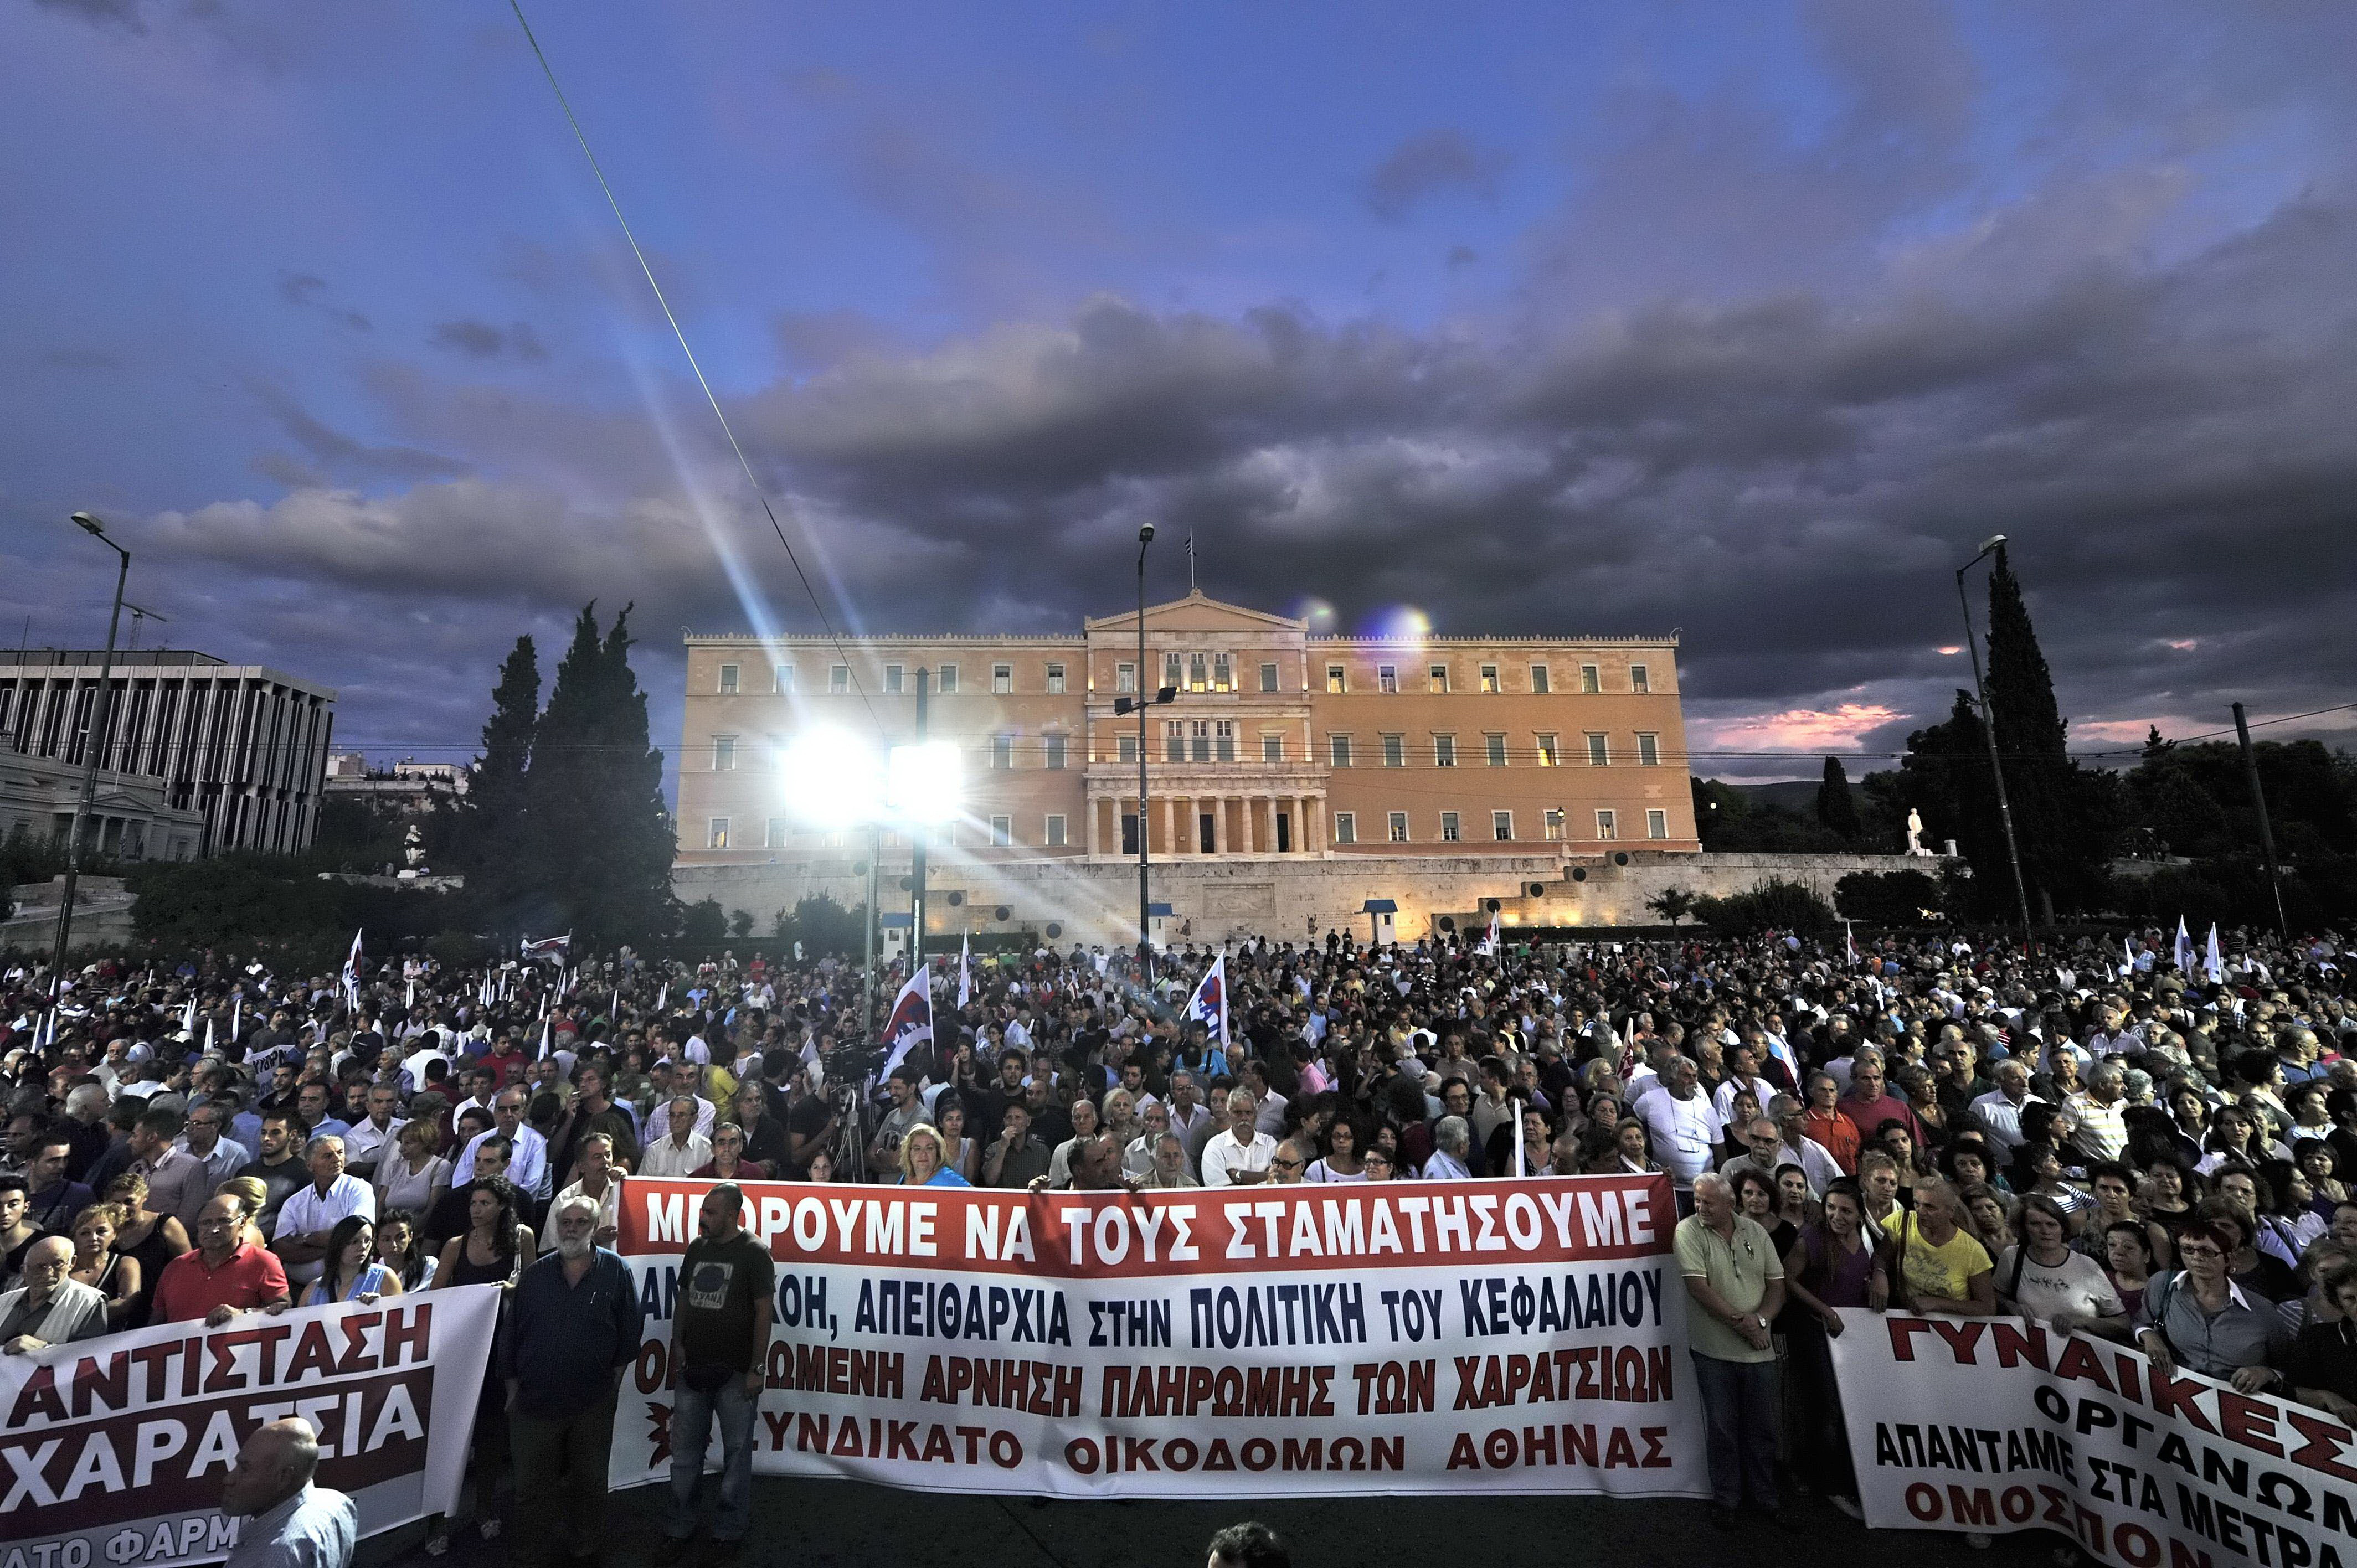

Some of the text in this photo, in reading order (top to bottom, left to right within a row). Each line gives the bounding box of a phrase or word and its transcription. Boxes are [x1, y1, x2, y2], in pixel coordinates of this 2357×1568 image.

[965, 1204, 1036, 1262] ΝΑ
[1061, 1205, 1199, 1265] ΤΟΥΣ
[1225, 1189, 1655, 1258] ΣΤΑΜΑΤΗΣΟΥΜΕ
[854, 1279, 1071, 1347] ΑΠΕΙΘΑΡΧΙΑ
[1089, 1298, 1171, 1347] ΣΤΗΝ
[1190, 1282, 1367, 1349] ΠΟΛΙΤΙΚΗ
[1381, 1289, 1442, 1344] ΤΟΥ
[1460, 1268, 1662, 1337] ΚΕΦΑΛΑΙΟΥ
[7, 1303, 433, 1428] ΑΝΤΙΣΤΑΣΗ
[921, 1354, 1082, 1417] ΑΡΝΗΣΗ
[1101, 1365, 1335, 1417] ΠΛΗΡΩΜΗΣ
[1352, 1359, 1436, 1415] ΤΩΝ
[1453, 1345, 1673, 1411] ΧΑΡΑΤΣΙΩΝ
[1886, 1317, 2357, 1484] ΓΥΝΑΙΚΕΣ
[753, 1410, 1672, 1475] ΥΝΔΙΚΑΤΟ ΟΙΚΟΔΟΜΩΝ ΑΘΗΝΑΣ
[1877, 1422, 2078, 1488] ΑΠΑΝΤΑΜΕ
[2088, 1456, 2168, 1519] ΣΤΑ
